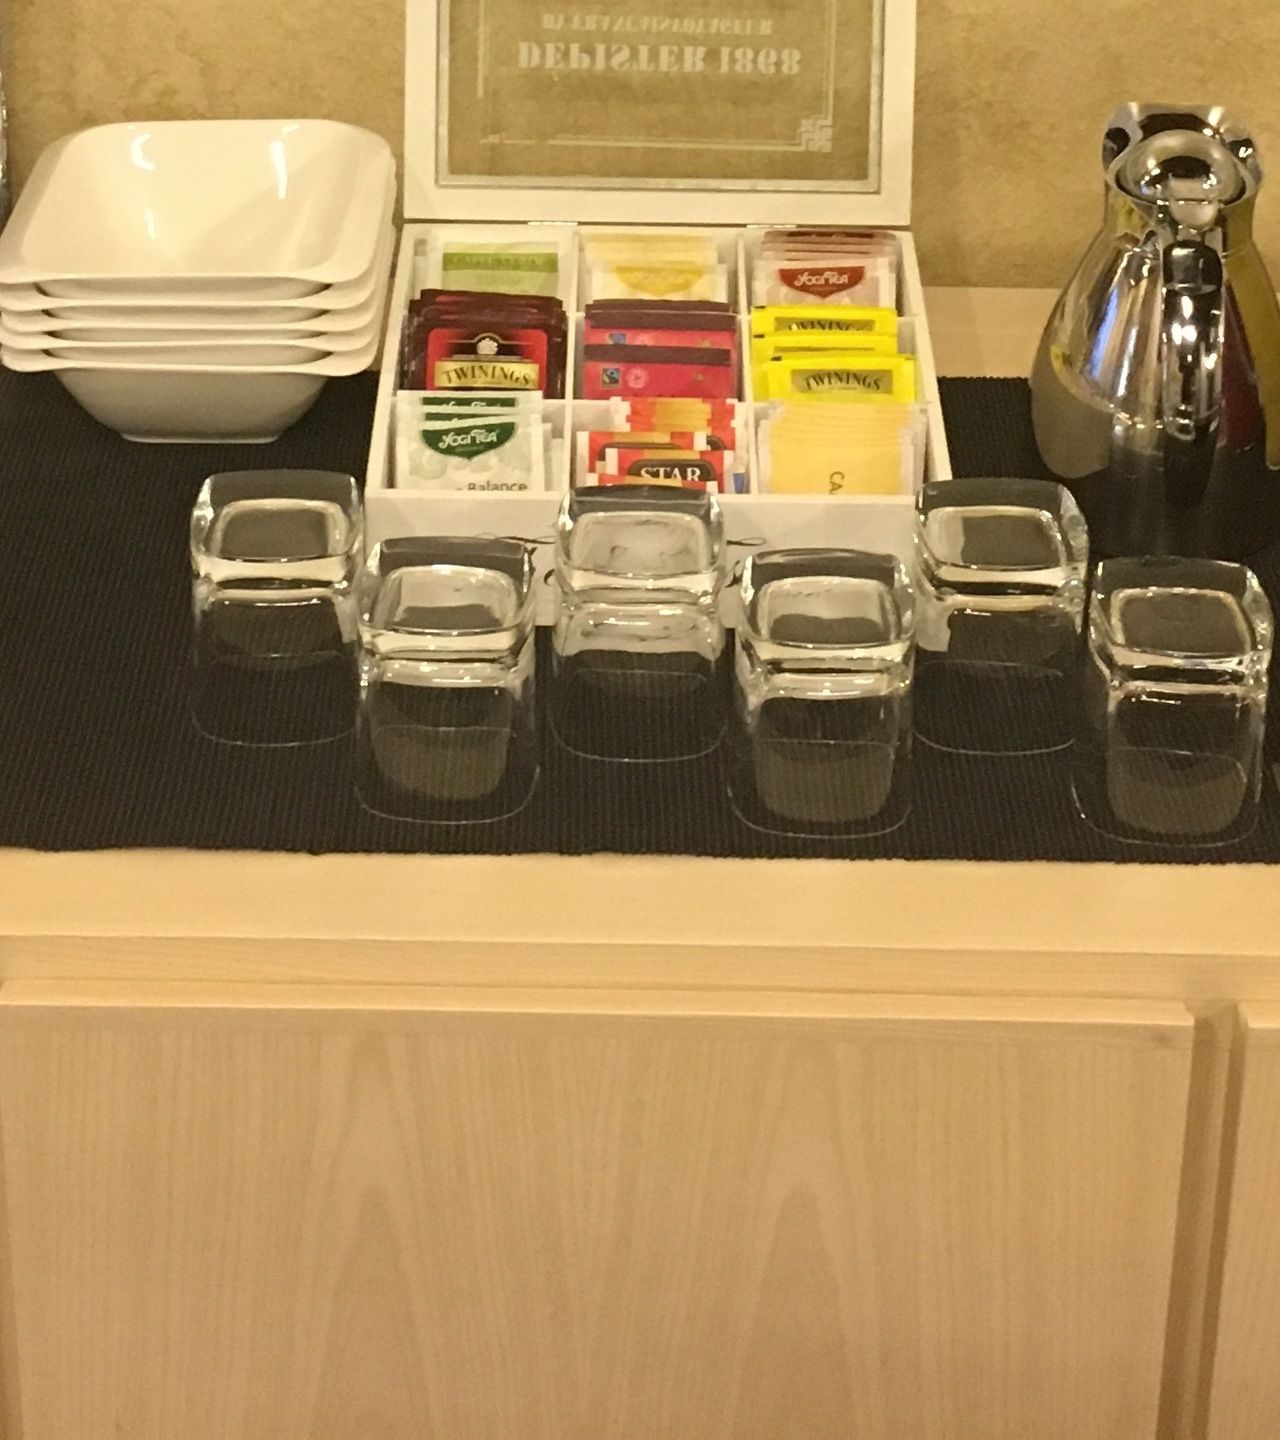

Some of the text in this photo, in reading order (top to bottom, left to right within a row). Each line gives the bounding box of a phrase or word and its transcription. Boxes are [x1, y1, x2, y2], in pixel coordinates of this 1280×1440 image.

[443, 364, 530, 386] TWININGS
[803, 371, 882, 391] TWININGS
[639, 466, 702, 482] STAR
[829, 471, 846, 495] CA
[467, 480, 529, 491] Balance
